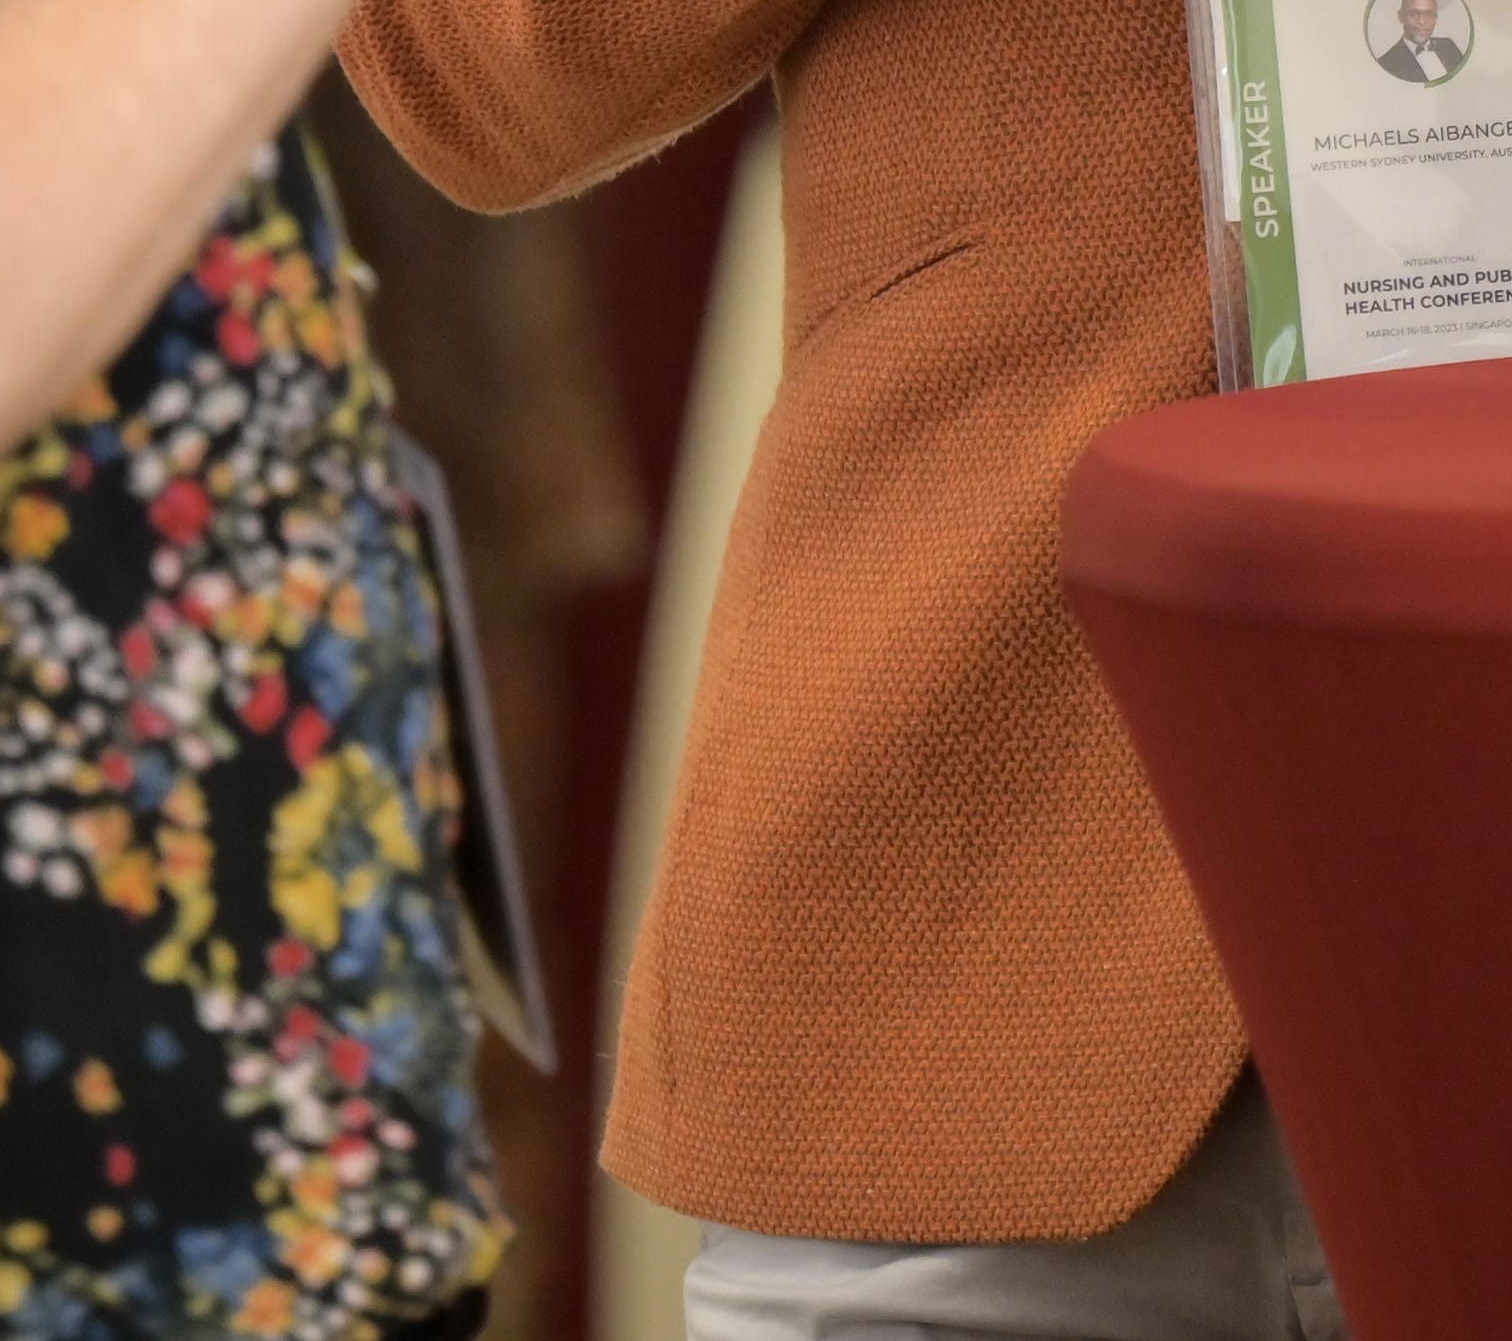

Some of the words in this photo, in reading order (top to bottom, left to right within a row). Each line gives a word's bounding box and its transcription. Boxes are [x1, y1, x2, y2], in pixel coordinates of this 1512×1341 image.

[1314, 128, 1419, 151] MICHAELS
[1243, 81, 1279, 238] SPEAKER
[1310, 158, 1367, 172] WESTERN
[1370, 154, 1416, 168] SYDNEY
[1403, 255, 1477, 267] INTERNATIONAL
[1344, 276, 1425, 295] NURSING
[1430, 272, 1469, 288] AND
[1345, 297, 1415, 315] HEALTH
[1366, 327, 1405, 339] MARCH
[1434, 323, 1459, 334] 2023
